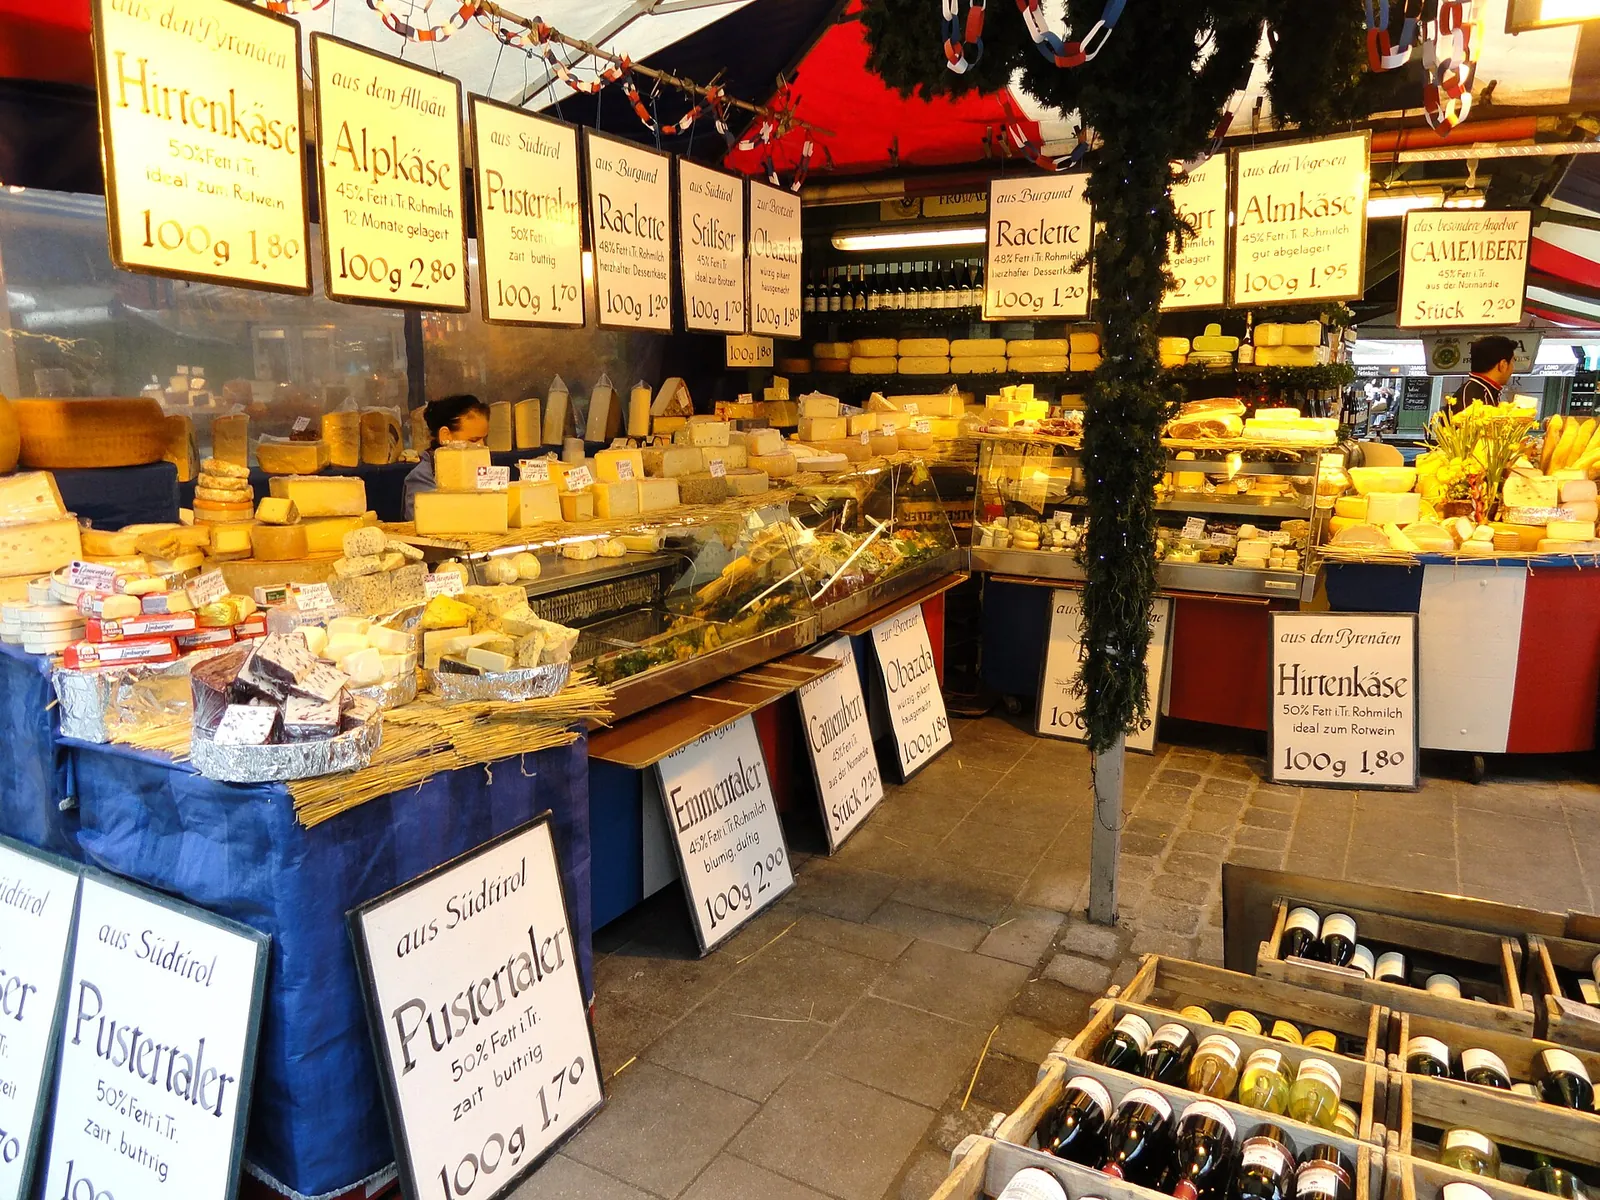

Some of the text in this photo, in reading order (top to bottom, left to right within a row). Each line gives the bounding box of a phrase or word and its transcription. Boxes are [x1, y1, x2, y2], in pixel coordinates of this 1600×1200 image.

[160, 6, 195, 37] den
[114, 51, 297, 154] Hirtenkäse
[332, 72, 446, 118] aus dem Allgäu
[329, 120, 451, 191] Alpkäse
[490, 131, 560, 160] aus Südtirol
[595, 157, 658, 184] aus Burgund
[1243, 155, 1346, 178] aus den Vogesen
[146, 166, 188, 188] ideal
[233, 183, 285, 210] Rotwein
[336, 182, 454, 219] 45% Fett Rohmilch
[485, 168, 578, 224] Pustertaler
[689, 181, 734, 202] aus Südtirol
[996, 185, 1073, 204] aus Burgund
[598, 193, 665, 242] Raclette
[757, 199, 768, 210] zur
[1239, 190, 1356, 226] Almkäse
[141, 209, 300, 270] 100g 1.80
[343, 209, 449, 243] 12 Monate gelagert
[691, 212, 736, 253] Stilfser
[996, 218, 1080, 247] Raclette
[1242, 224, 1349, 243] 45% Fett Rohmilch
[1414, 216, 1519, 234] das besondere Angebot
[509, 250, 556, 269] zart buttrig
[599, 240, 664, 262] 48% Fett Rohmilch
[754, 227, 798, 265] Obazda
[994, 253, 1013, 264] 48%
[1014, 253, 1030, 263] Fett
[1252, 244, 1331, 262] gut abgelagert
[1411, 240, 1527, 262] CAMEMBERT
[339, 247, 456, 292] 100g 2.80
[599, 259, 667, 280] herzhafter Dessertkäse
[1244, 263, 1348, 295] 100g 1.95
[1426, 280, 1499, 290] aus der Normandie
[497, 278, 577, 315] 100g 1.70
[607, 288, 668, 321] 100g 1.20
[692, 295, 742, 325] 100g 1.70
[995, 289, 1044, 312] 100g
[1053, 286, 1084, 308] 1.20
[1415, 298, 1516, 320] Stück 2.20
[756, 303, 800, 329] 100g 1.80
[730, 345, 754, 364] 100g
[1056, 604, 1078, 614] aus
[144, 623, 174, 632] Limburger
[183, 635, 211, 644] Limburger
[880, 613, 919, 643] zur Brotzeit
[1281, 628, 1401, 648] aus den Pyrenäen
[121, 649, 151, 658] Limburger
[886, 643, 933, 694] Obazda
[1277, 663, 1408, 698] Hirtenkäse
[809, 695, 862, 754] Camembert
[902, 700, 931, 726] hausgemacht
[1283, 704, 1309, 716] 50%
[1312, 705, 1332, 716] Fett
[1353, 706, 1402, 718] Rohmilch
[903, 715, 947, 765] 100g 1.80
[1293, 723, 1395, 735] ideal zum Rotwein
[828, 776, 838, 790] aus
[847, 746, 869, 772] Normandie
[1284, 747, 1404, 778] 100g 1.80
[670, 756, 761, 834] Emmentaler
[832, 767, 877, 831] Stück 2.20
[689, 801, 767, 855] 45% Fett Rohmilch
[704, 847, 784, 930] 100g 2.00
[396, 856, 527, 958] aus Südtirol
[98, 924, 218, 988] aus Südtirol
[391, 925, 565, 1077] Pustertaler
[71, 979, 234, 1118] Pustertaler
[452, 1039, 489, 1082] 50%
[491, 1023, 518, 1054] Fett
[452, 1044, 543, 1121] zart buttrig
[97, 1079, 127, 1115] 50%
[128, 1097, 154, 1128] Fett
[437, 1056, 585, 1200] 100g 1.70
[120, 1131, 168, 1183] buttrig
